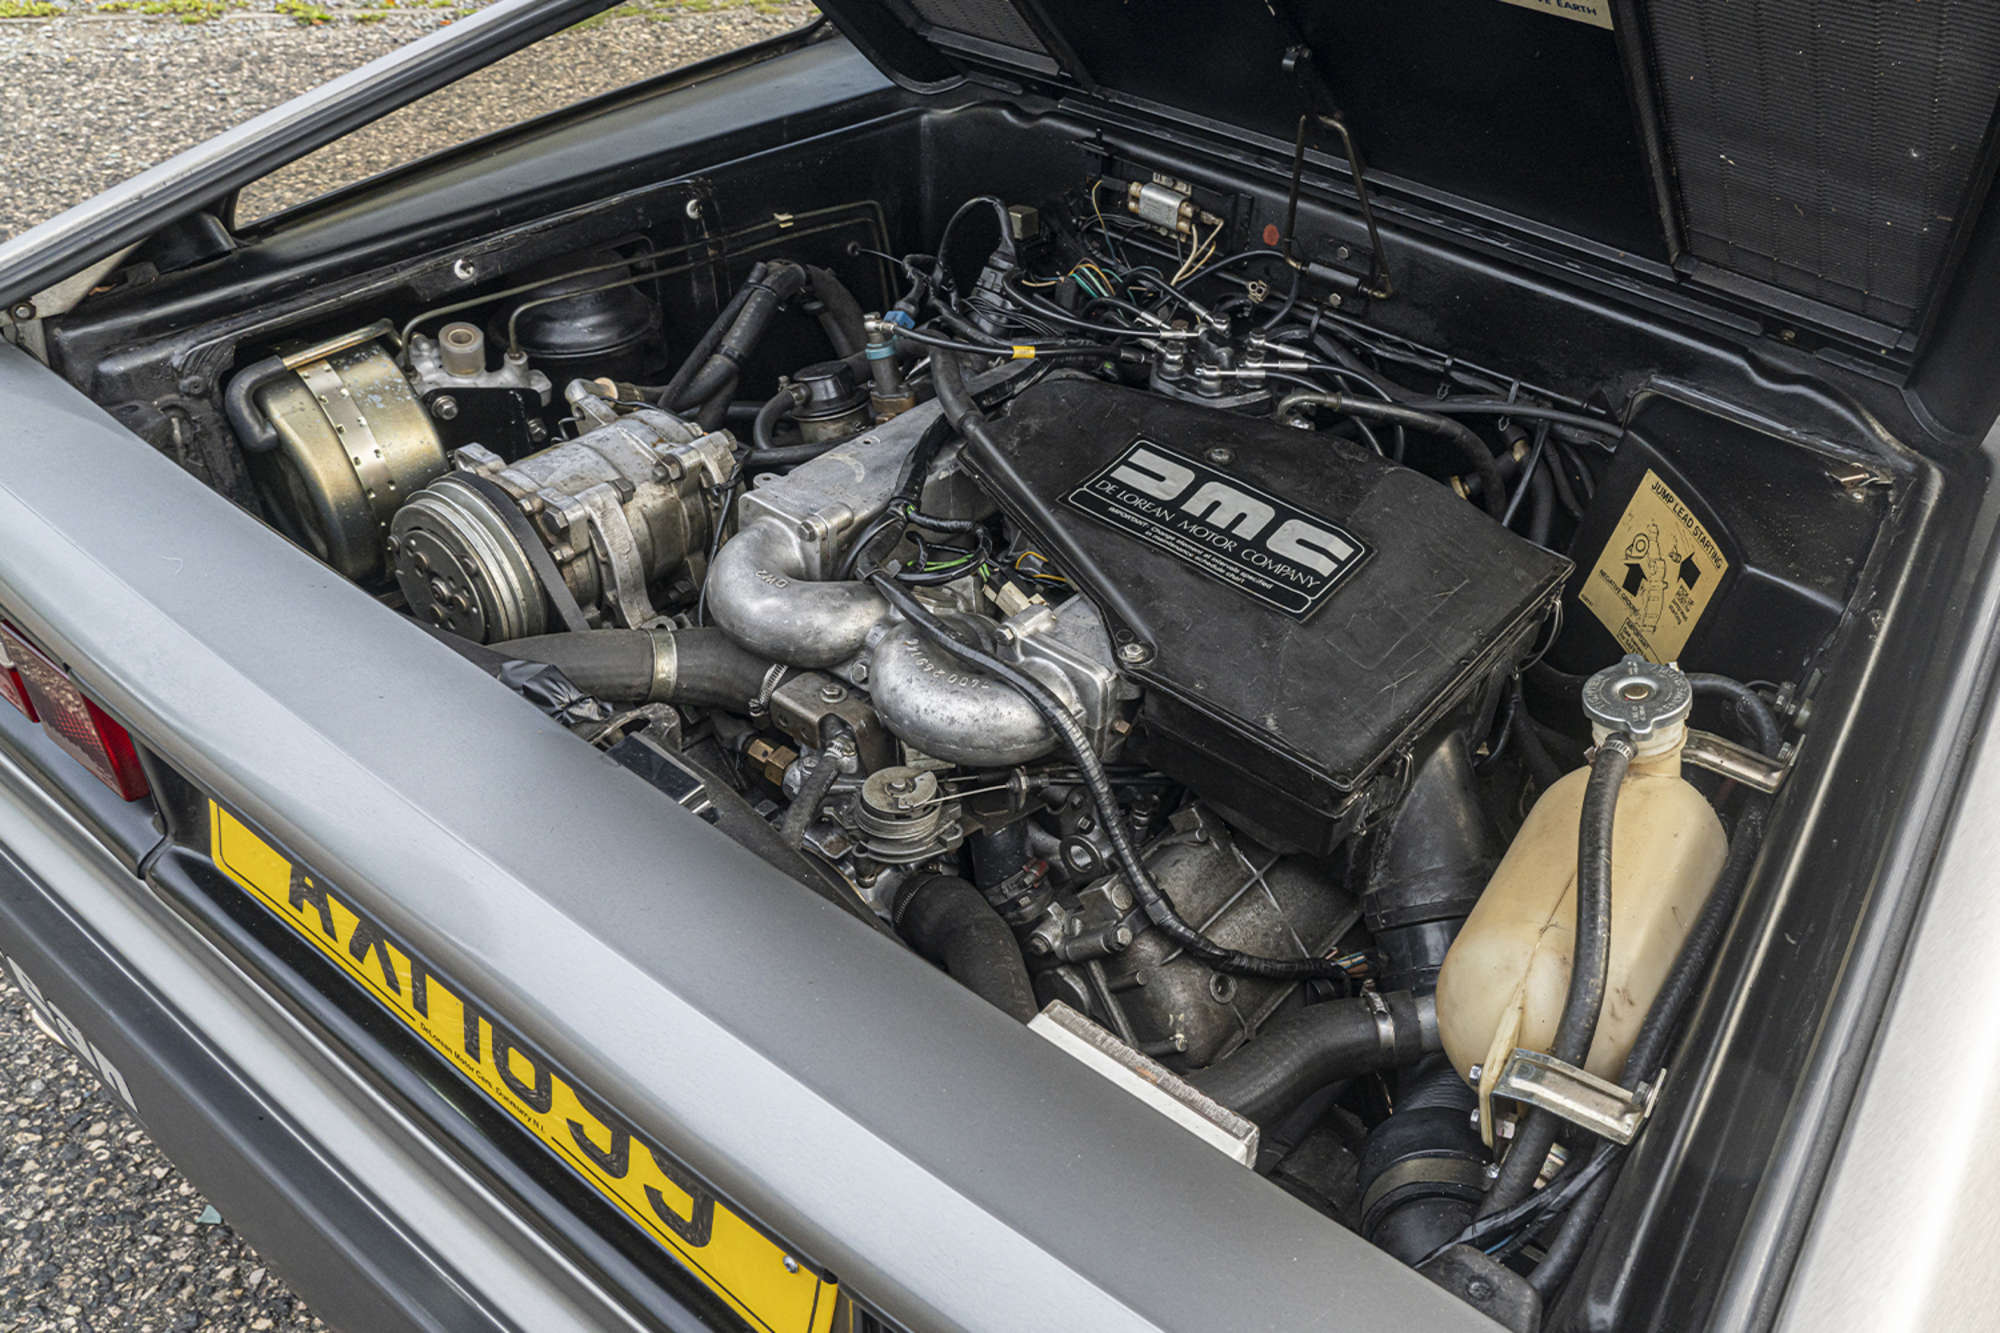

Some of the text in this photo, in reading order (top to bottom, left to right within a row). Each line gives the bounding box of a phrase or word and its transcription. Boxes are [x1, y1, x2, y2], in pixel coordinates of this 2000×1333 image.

[1095, 480, 1321, 588] DE LOREAN MOTOR COMPANY
[1651, 481, 1724, 570] JUMP LEAD STARTING
[1240, 571, 1273, 590] specified
[454, 1051, 475, 1072] Motor
